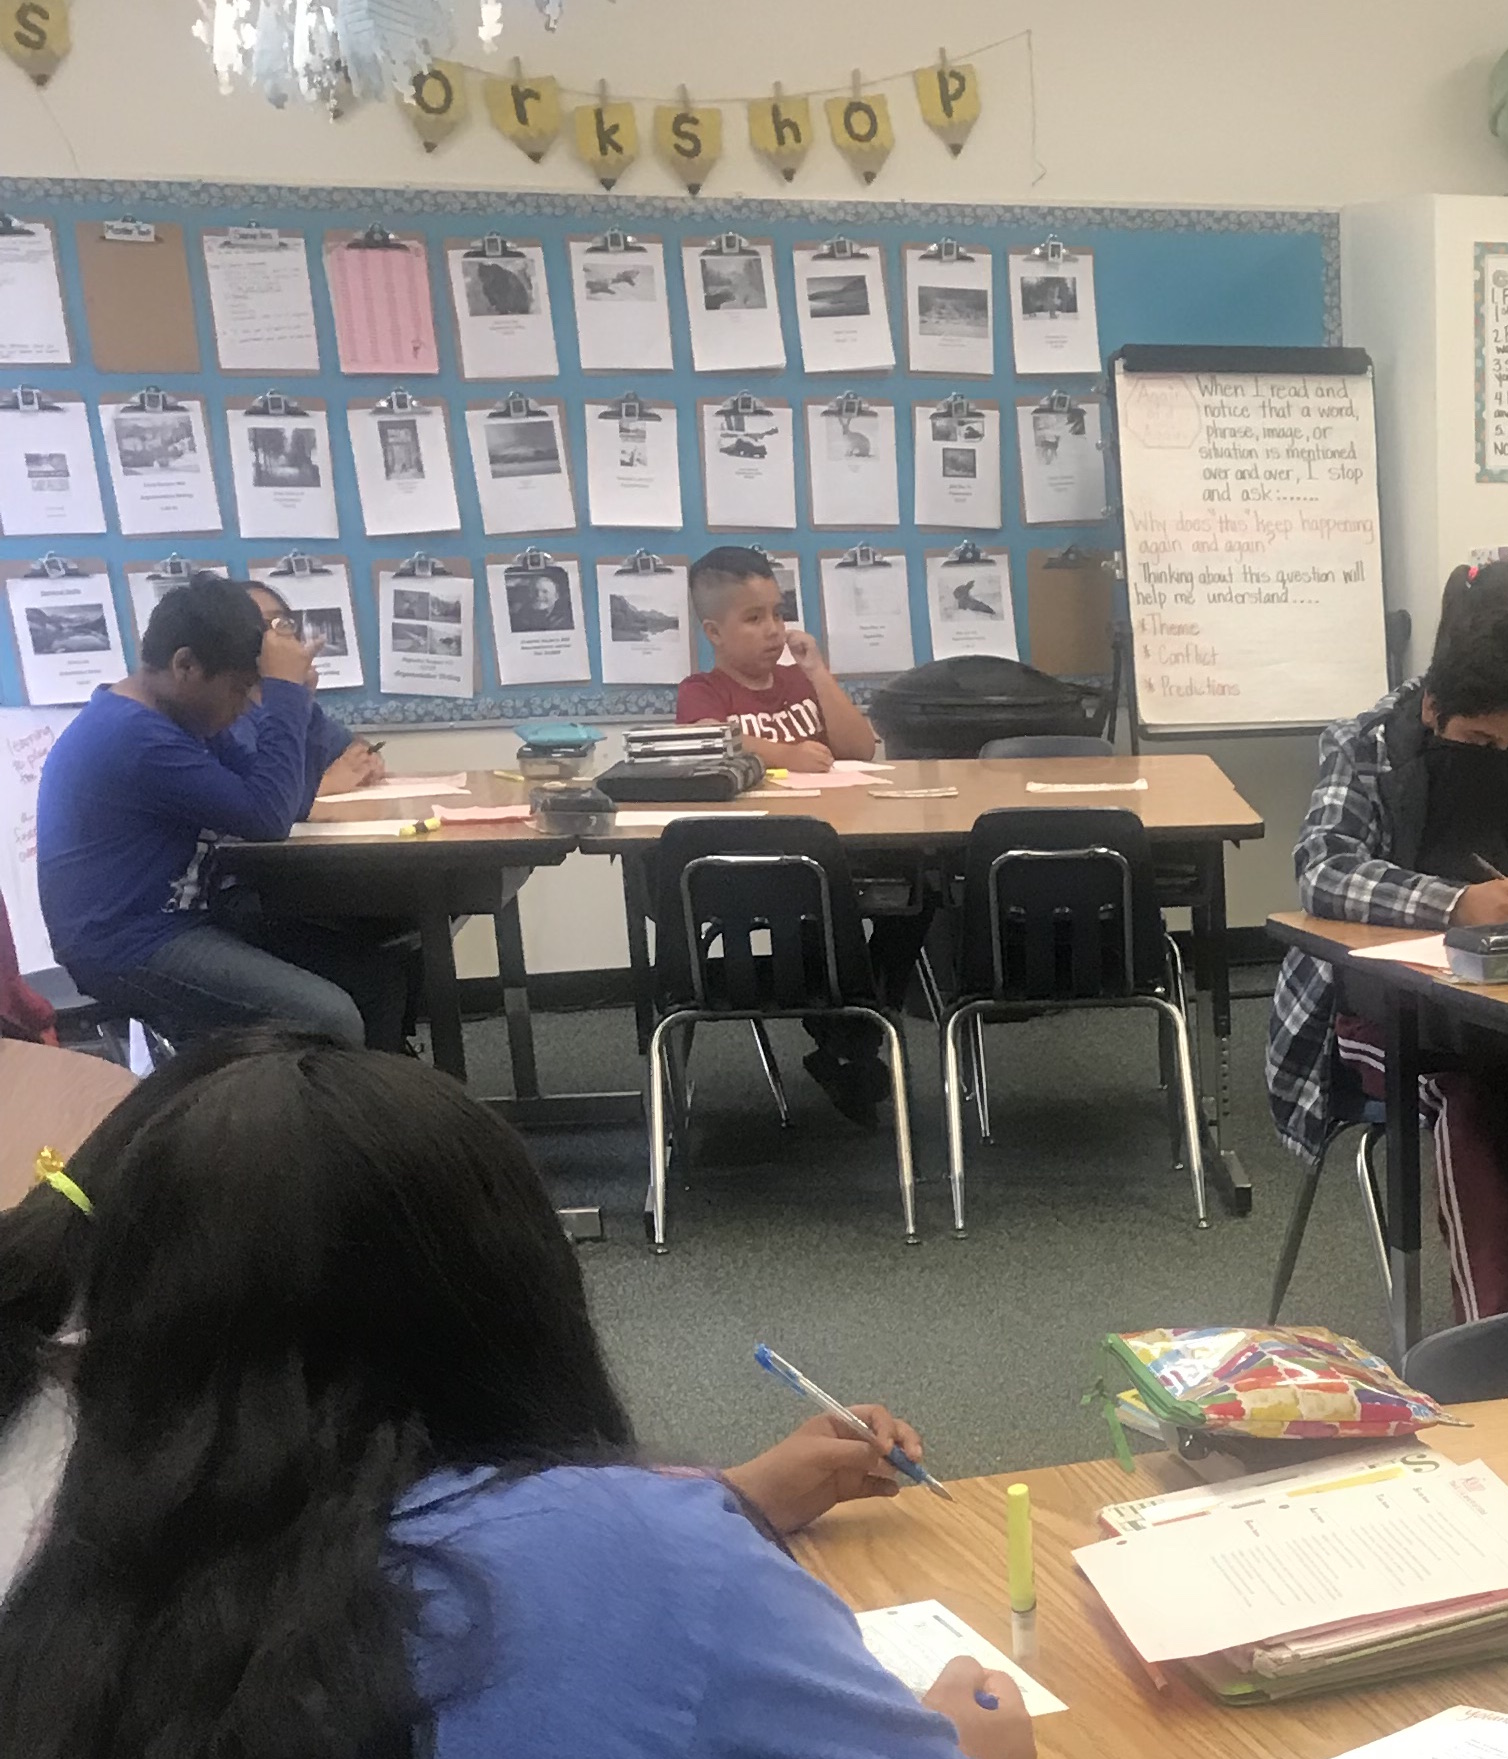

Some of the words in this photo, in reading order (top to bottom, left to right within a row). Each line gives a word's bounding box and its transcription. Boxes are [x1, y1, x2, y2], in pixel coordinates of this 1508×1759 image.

[1196, 373, 1245, 399] When
[1252, 375, 1266, 399] I
[1270, 378, 1310, 400] read
[1315, 377, 1349, 399] and
[1204, 401, 1250, 419] notice
[1261, 399, 1292, 419] that
[1301, 404, 1311, 418] a
[1312, 424, 1334, 440] or
[1198, 444, 1258, 460] situation
[1266, 445, 1281, 460] is
[1285, 441, 1358, 461] mentioned
[1202, 467, 1231, 481] over
[1235, 463, 1260, 481] and
[1307, 459, 1320, 481] I
[1328, 463, 1364, 484] stop
[1202, 482, 1231, 501] and
[1129, 510, 1167, 537] Why
[1176, 510, 1212, 534] does
[1254, 510, 1294, 540] keep
[1299, 509, 1375, 545] happening
[1138, 537, 1182, 566] again
[1191, 533, 1219, 553] and
[1138, 561, 1195, 590] Thinking
[1198, 564, 1234, 584] about
[1241, 564, 1271, 584] this
[1275, 565, 1336, 588] question
[1342, 559, 1366, 585] will
[1134, 582, 1167, 610] help
[1174, 591, 1196, 605] me
[1146, 610, 1201, 637] Theme
[1158, 643, 1220, 667] Conflict
[1160, 675, 1242, 699] Predictions
